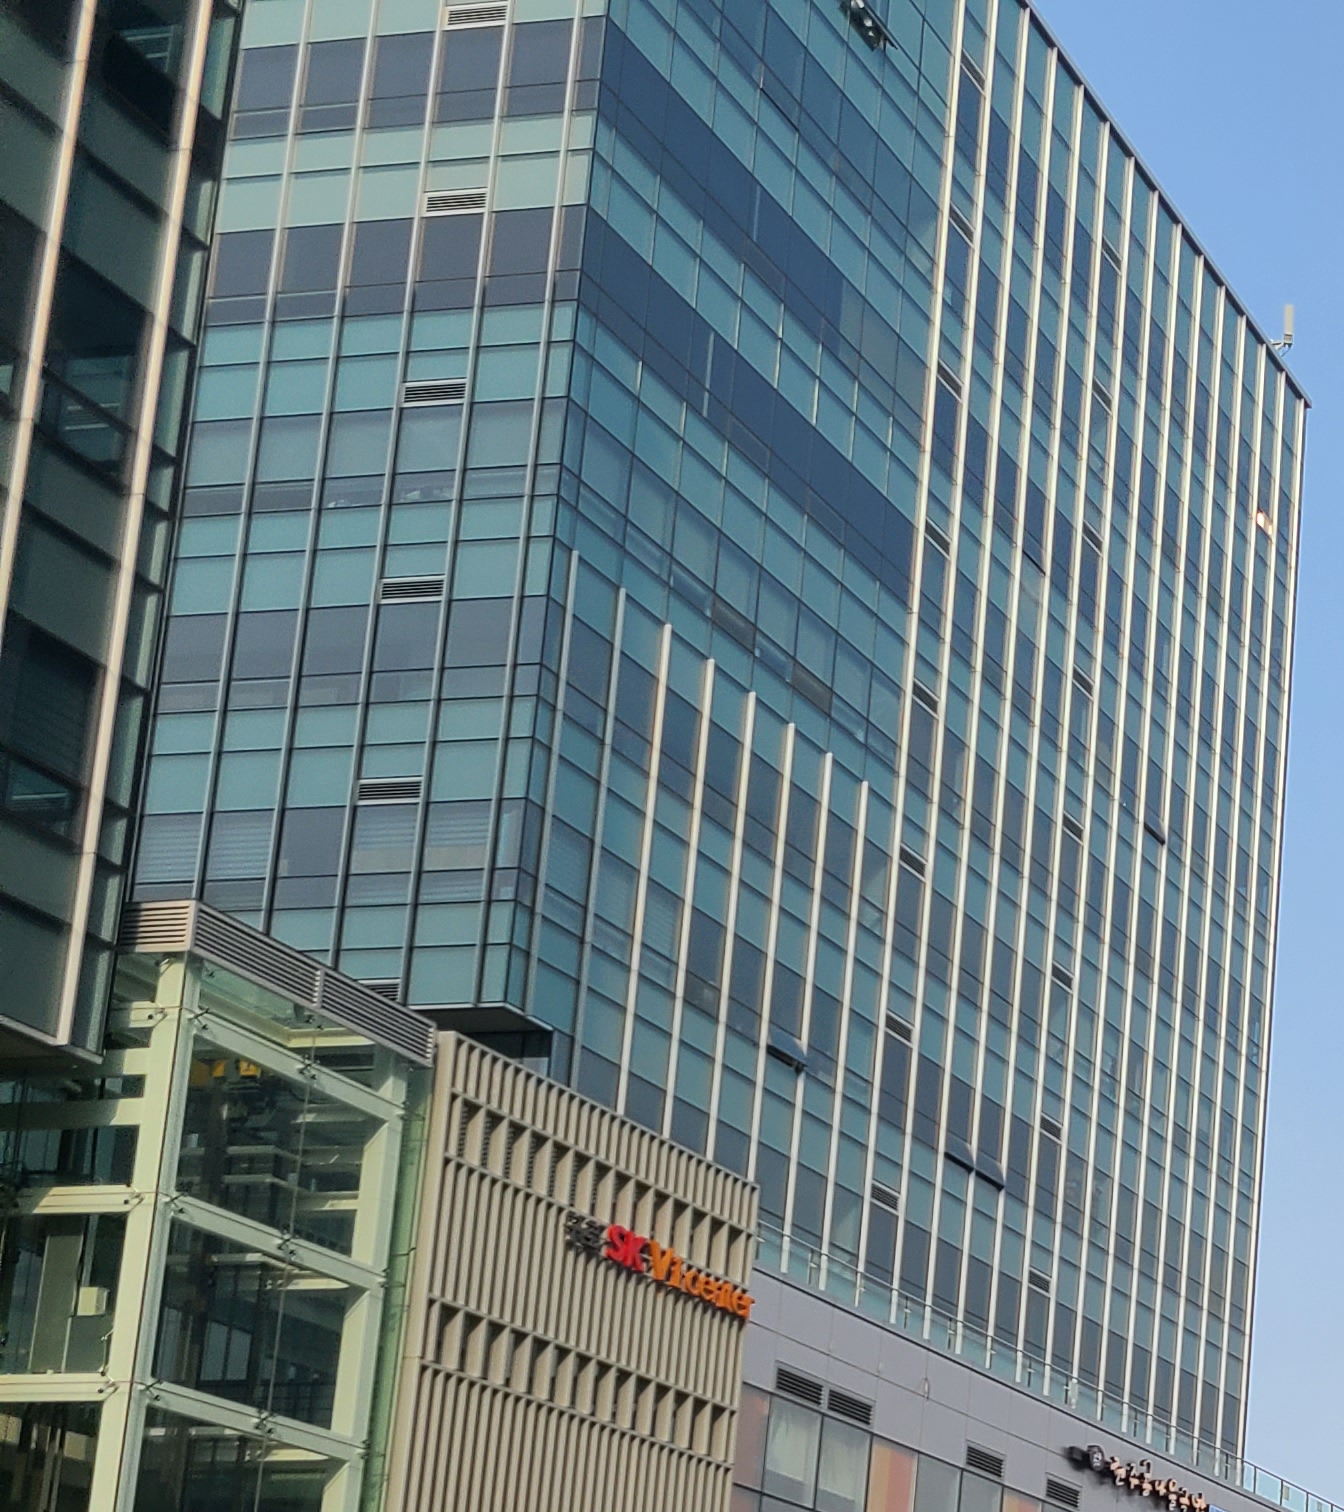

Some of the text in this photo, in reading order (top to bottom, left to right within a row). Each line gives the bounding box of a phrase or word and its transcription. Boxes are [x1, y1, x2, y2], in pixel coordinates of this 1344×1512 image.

[604, 1224, 648, 1272] SK
[650, 1240, 684, 1288] V1
[684, 1269, 755, 1318] center
